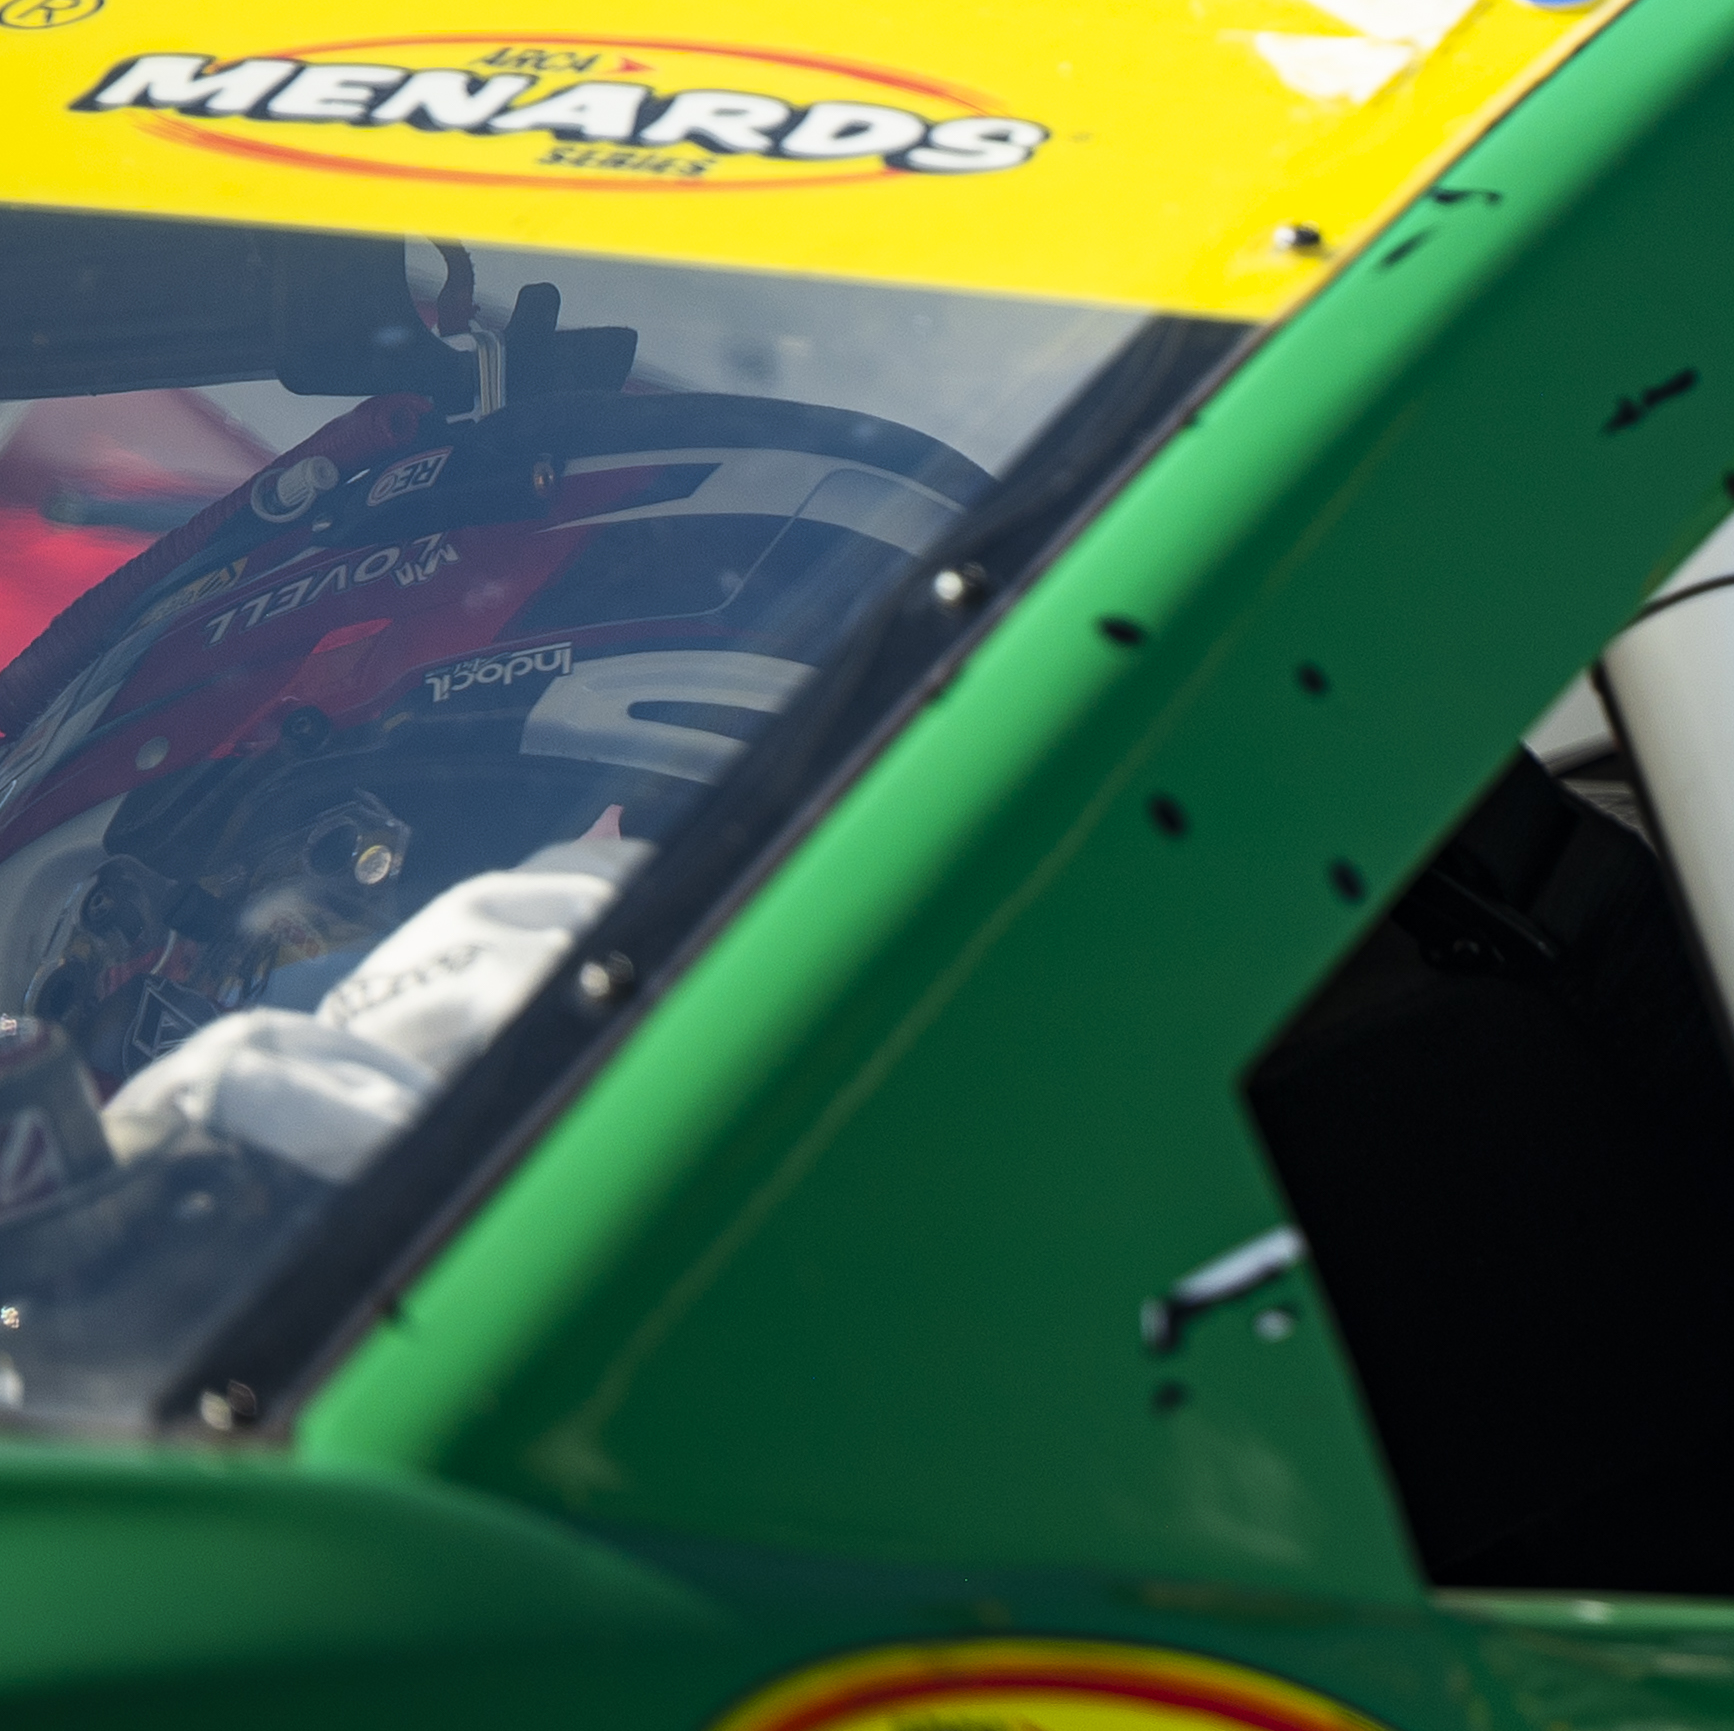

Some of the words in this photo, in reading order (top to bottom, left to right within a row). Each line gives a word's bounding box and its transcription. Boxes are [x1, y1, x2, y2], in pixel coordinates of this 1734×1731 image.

[472, 46, 599, 74] ARCA
[66, 52, 1052, 175] MENARDS
[536, 145, 719, 178] SERIES
[206, 533, 446, 645] LOVELL
